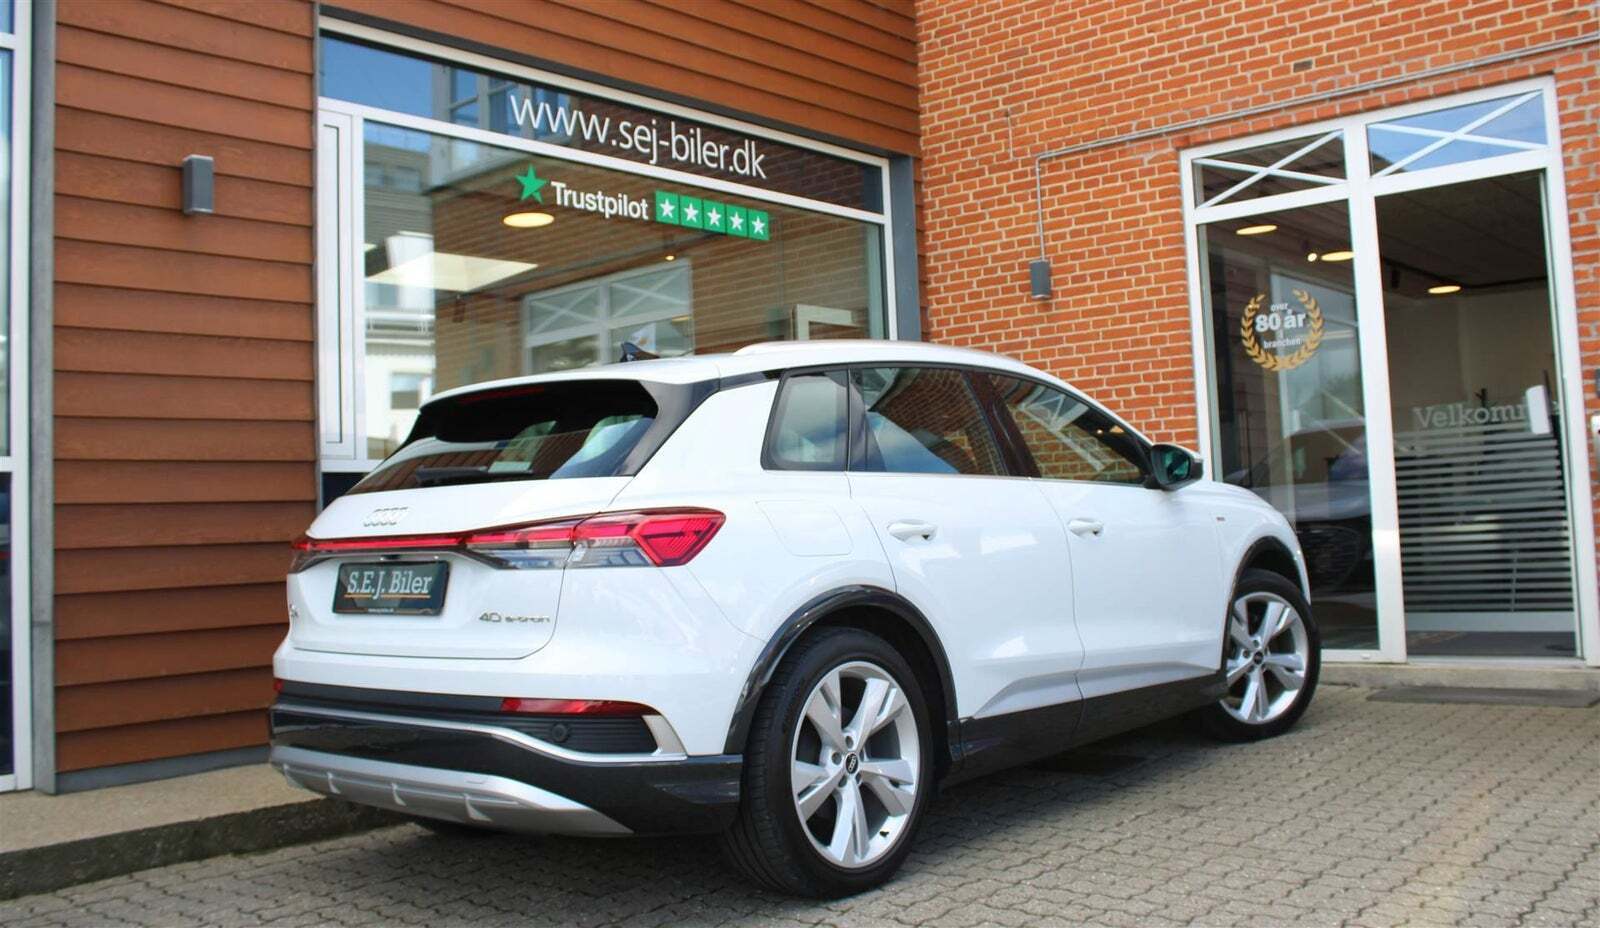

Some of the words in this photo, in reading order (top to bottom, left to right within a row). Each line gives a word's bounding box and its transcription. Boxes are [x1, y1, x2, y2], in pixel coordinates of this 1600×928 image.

[510, 95, 767, 179] www.sej-biler.dk
[550, 180, 648, 219] Trustpilot
[1255, 313, 1281, 332] 80
[1283, 308, 1306, 329] år
[1270, 303, 1288, 312] over
[1412, 402, 1560, 428] Velkom
[347, 570, 385, 600] S.E.J.
[388, 569, 432, 594] Biler
[479, 612, 502, 623] 40
